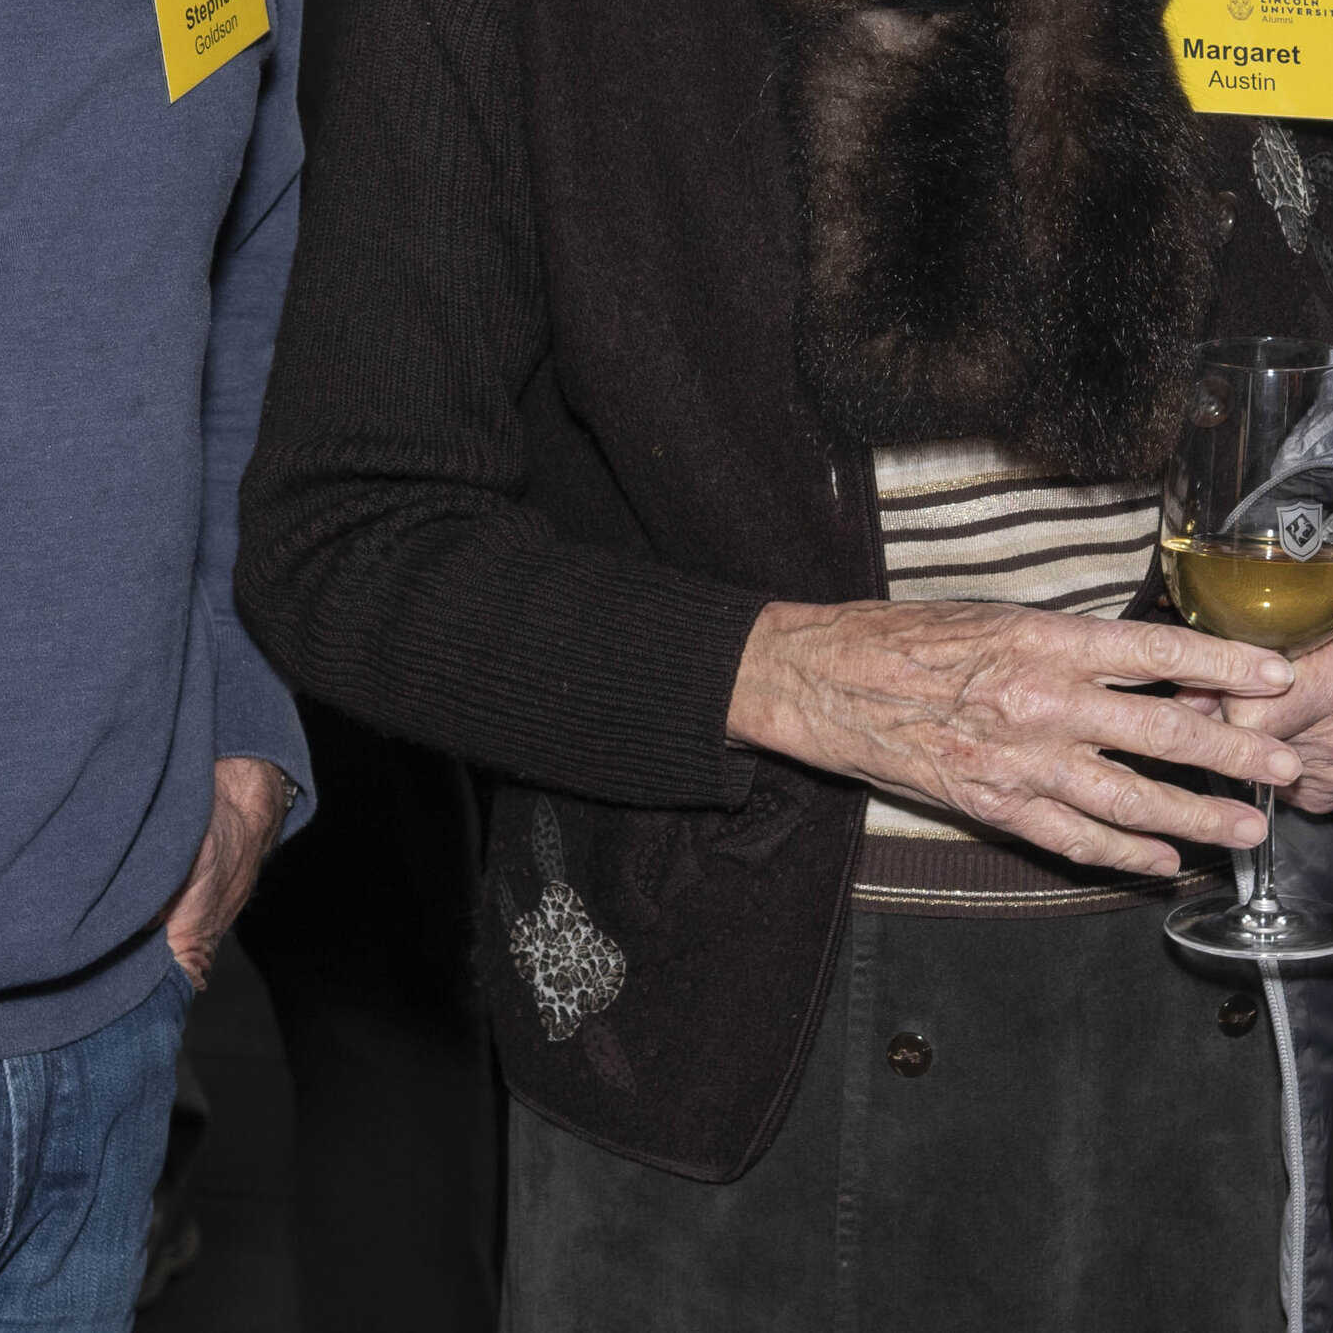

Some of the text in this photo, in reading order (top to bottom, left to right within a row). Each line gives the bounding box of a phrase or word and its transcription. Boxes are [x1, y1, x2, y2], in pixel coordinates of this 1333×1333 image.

[1261, 16, 1294, 25] Alumni
[194, 13, 239, 56] Goldson
[1183, 38, 1301, 67] Margaret
[1208, 69, 1276, 92] Austin
